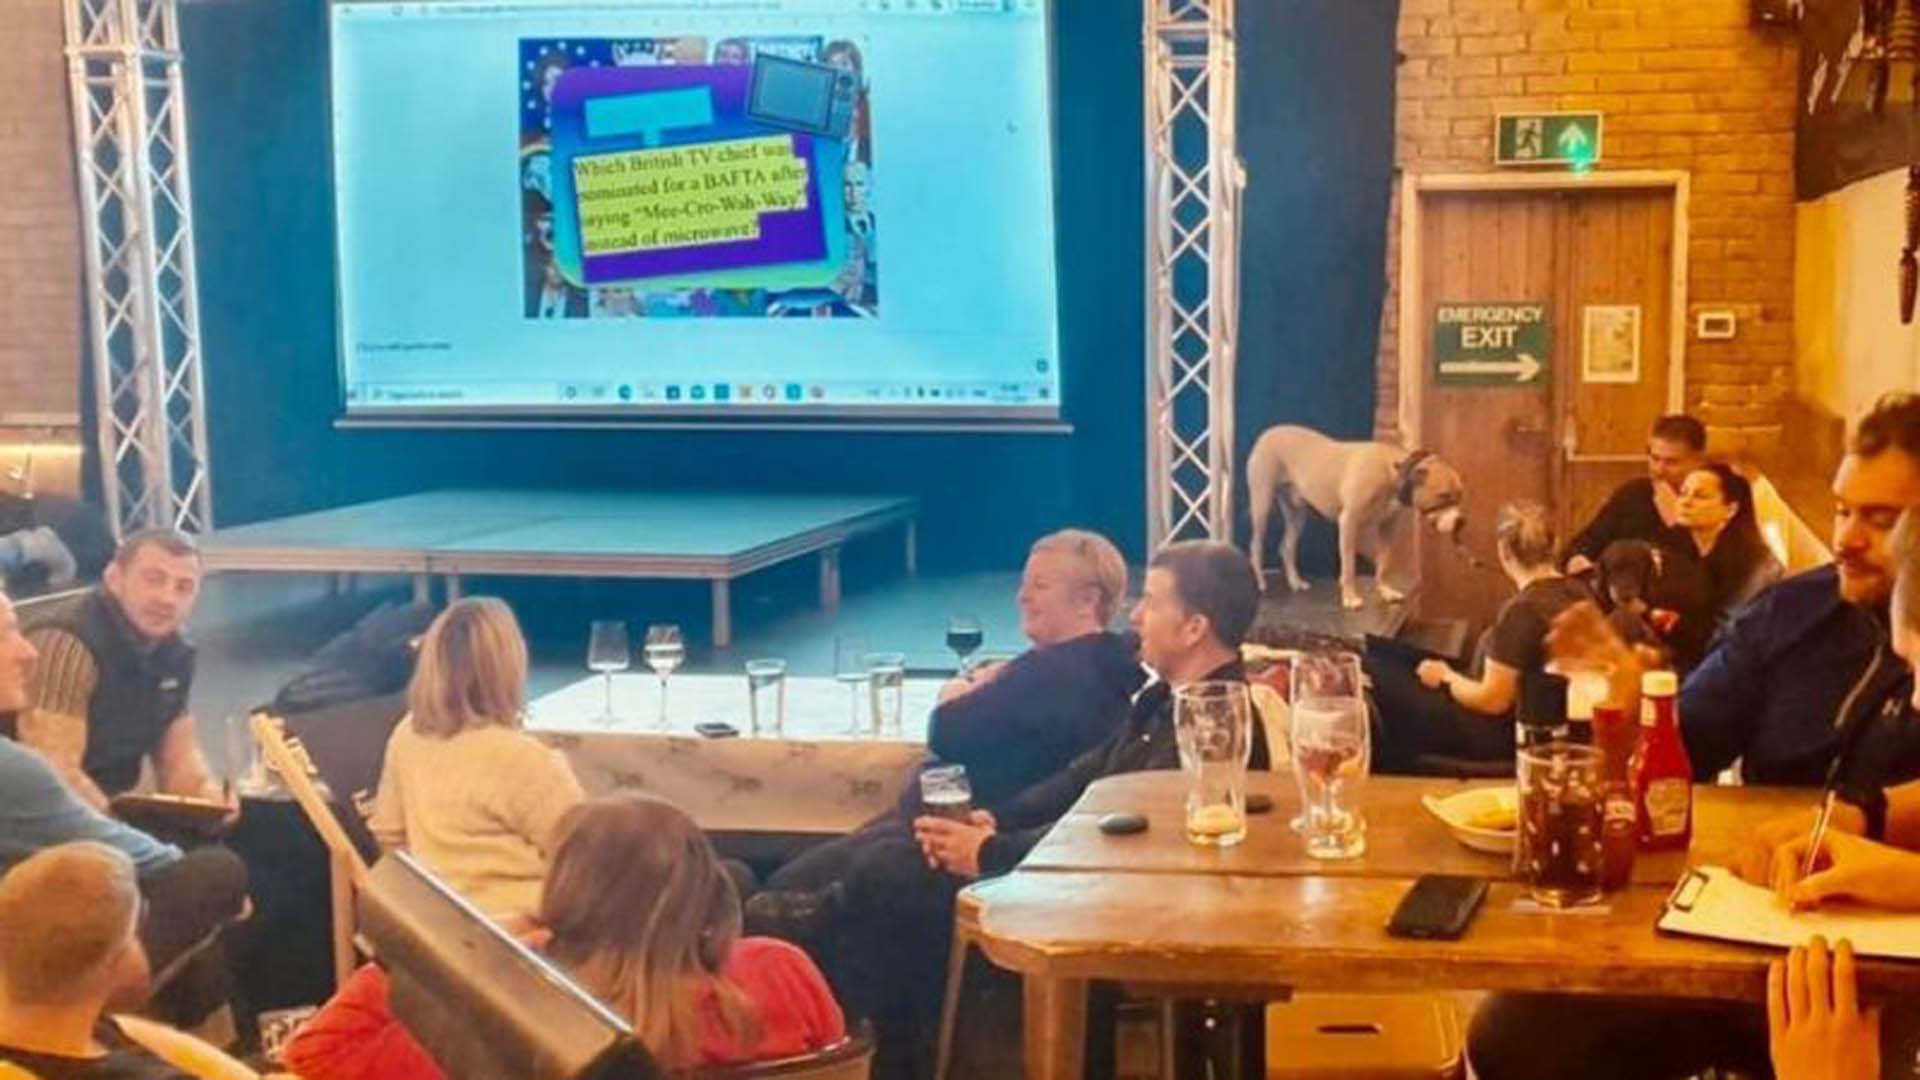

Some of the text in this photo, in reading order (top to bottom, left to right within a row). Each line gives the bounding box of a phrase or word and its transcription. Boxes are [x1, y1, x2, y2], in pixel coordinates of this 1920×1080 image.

[576, 155, 626, 177] Which
[630, 150, 683, 171] British
[687, 147, 715, 167] TV
[717, 142, 757, 163] chief
[662, 174, 687, 195] for
[690, 180, 700, 192] a
[703, 168, 766, 191] BAFTA
[583, 211, 629, 231] aying
[584, 231, 637, 251] nstead
[641, 228, 660, 246] of
[1438, 306, 1543, 324] EMERGENCY
[1461, 326, 1518, 348] EXIT
